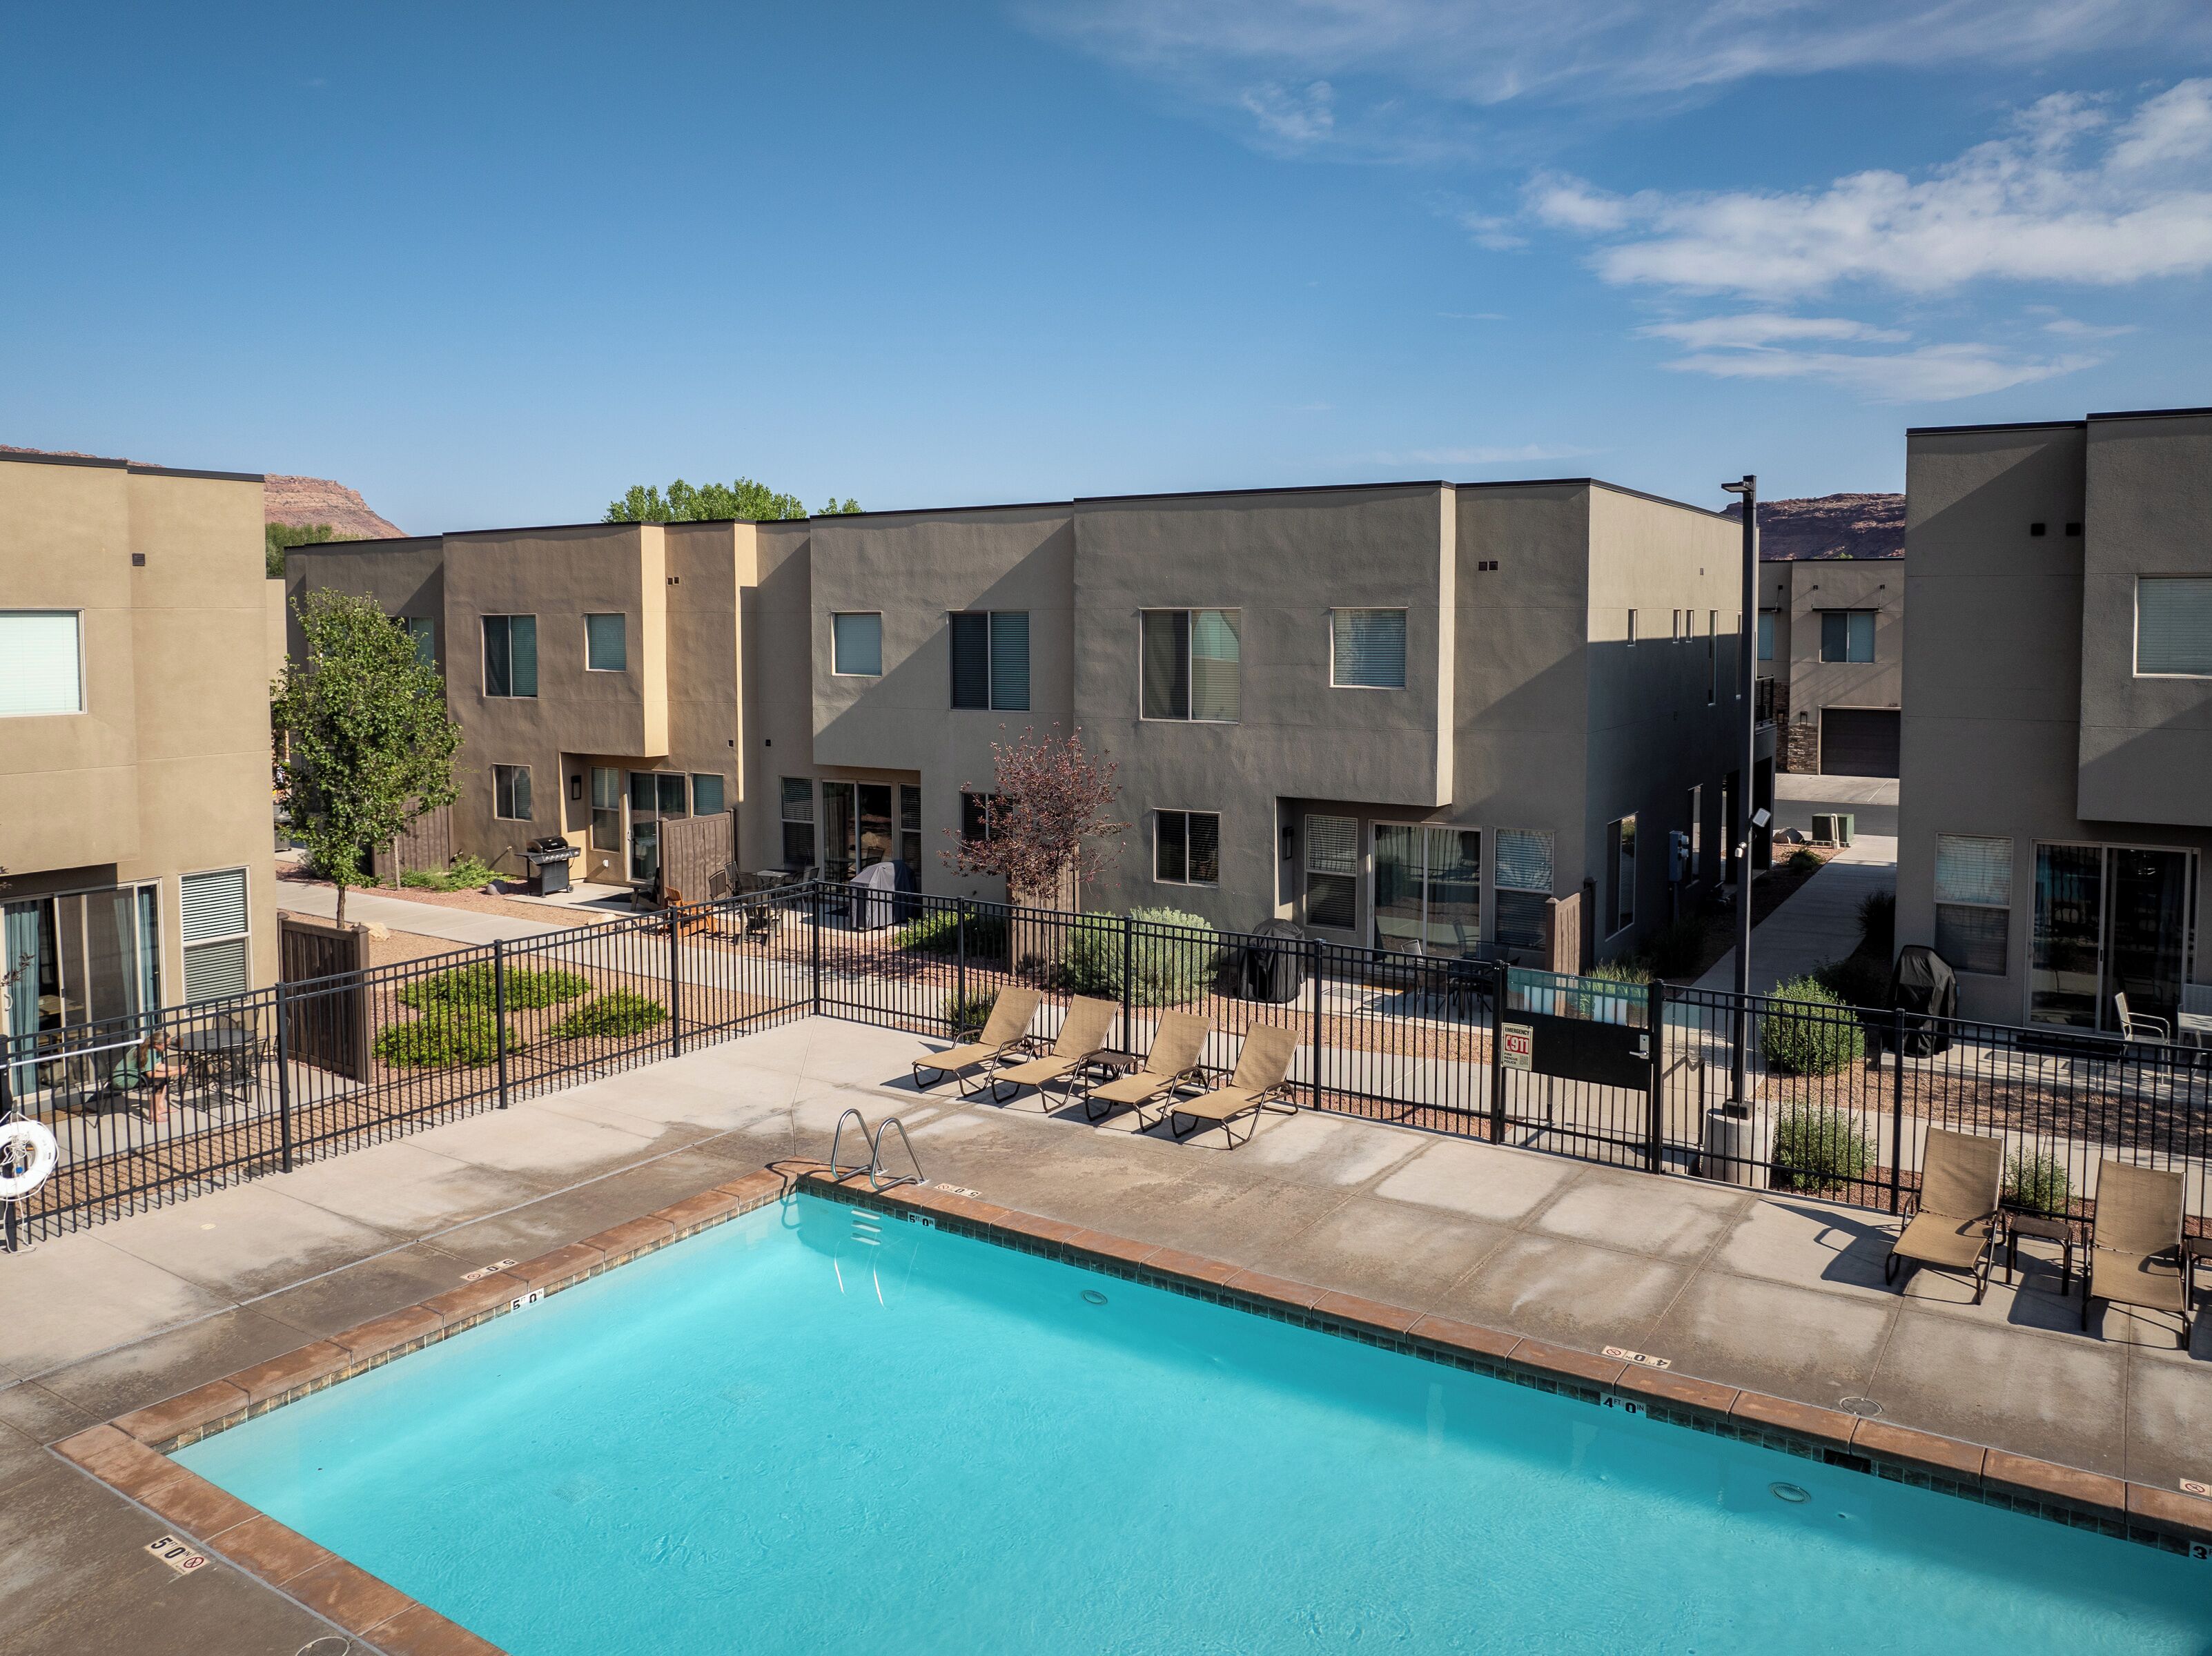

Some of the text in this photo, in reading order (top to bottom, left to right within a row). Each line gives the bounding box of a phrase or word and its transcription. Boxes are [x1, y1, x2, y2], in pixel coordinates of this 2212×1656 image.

[1505, 1027, 1529, 1036] EMERGENCY
[1511, 1037, 1529, 1053] 911
[513, 1300, 520, 1310] 5
[529, 1293, 537, 1303] 0
[1603, 1397, 1614, 1408] 4
[1625, 1402, 1636, 1413] 0
[150, 1537, 173, 1549] 5
[164, 1547, 186, 1559] 0
[2193, 1546, 2208, 1560] 3
